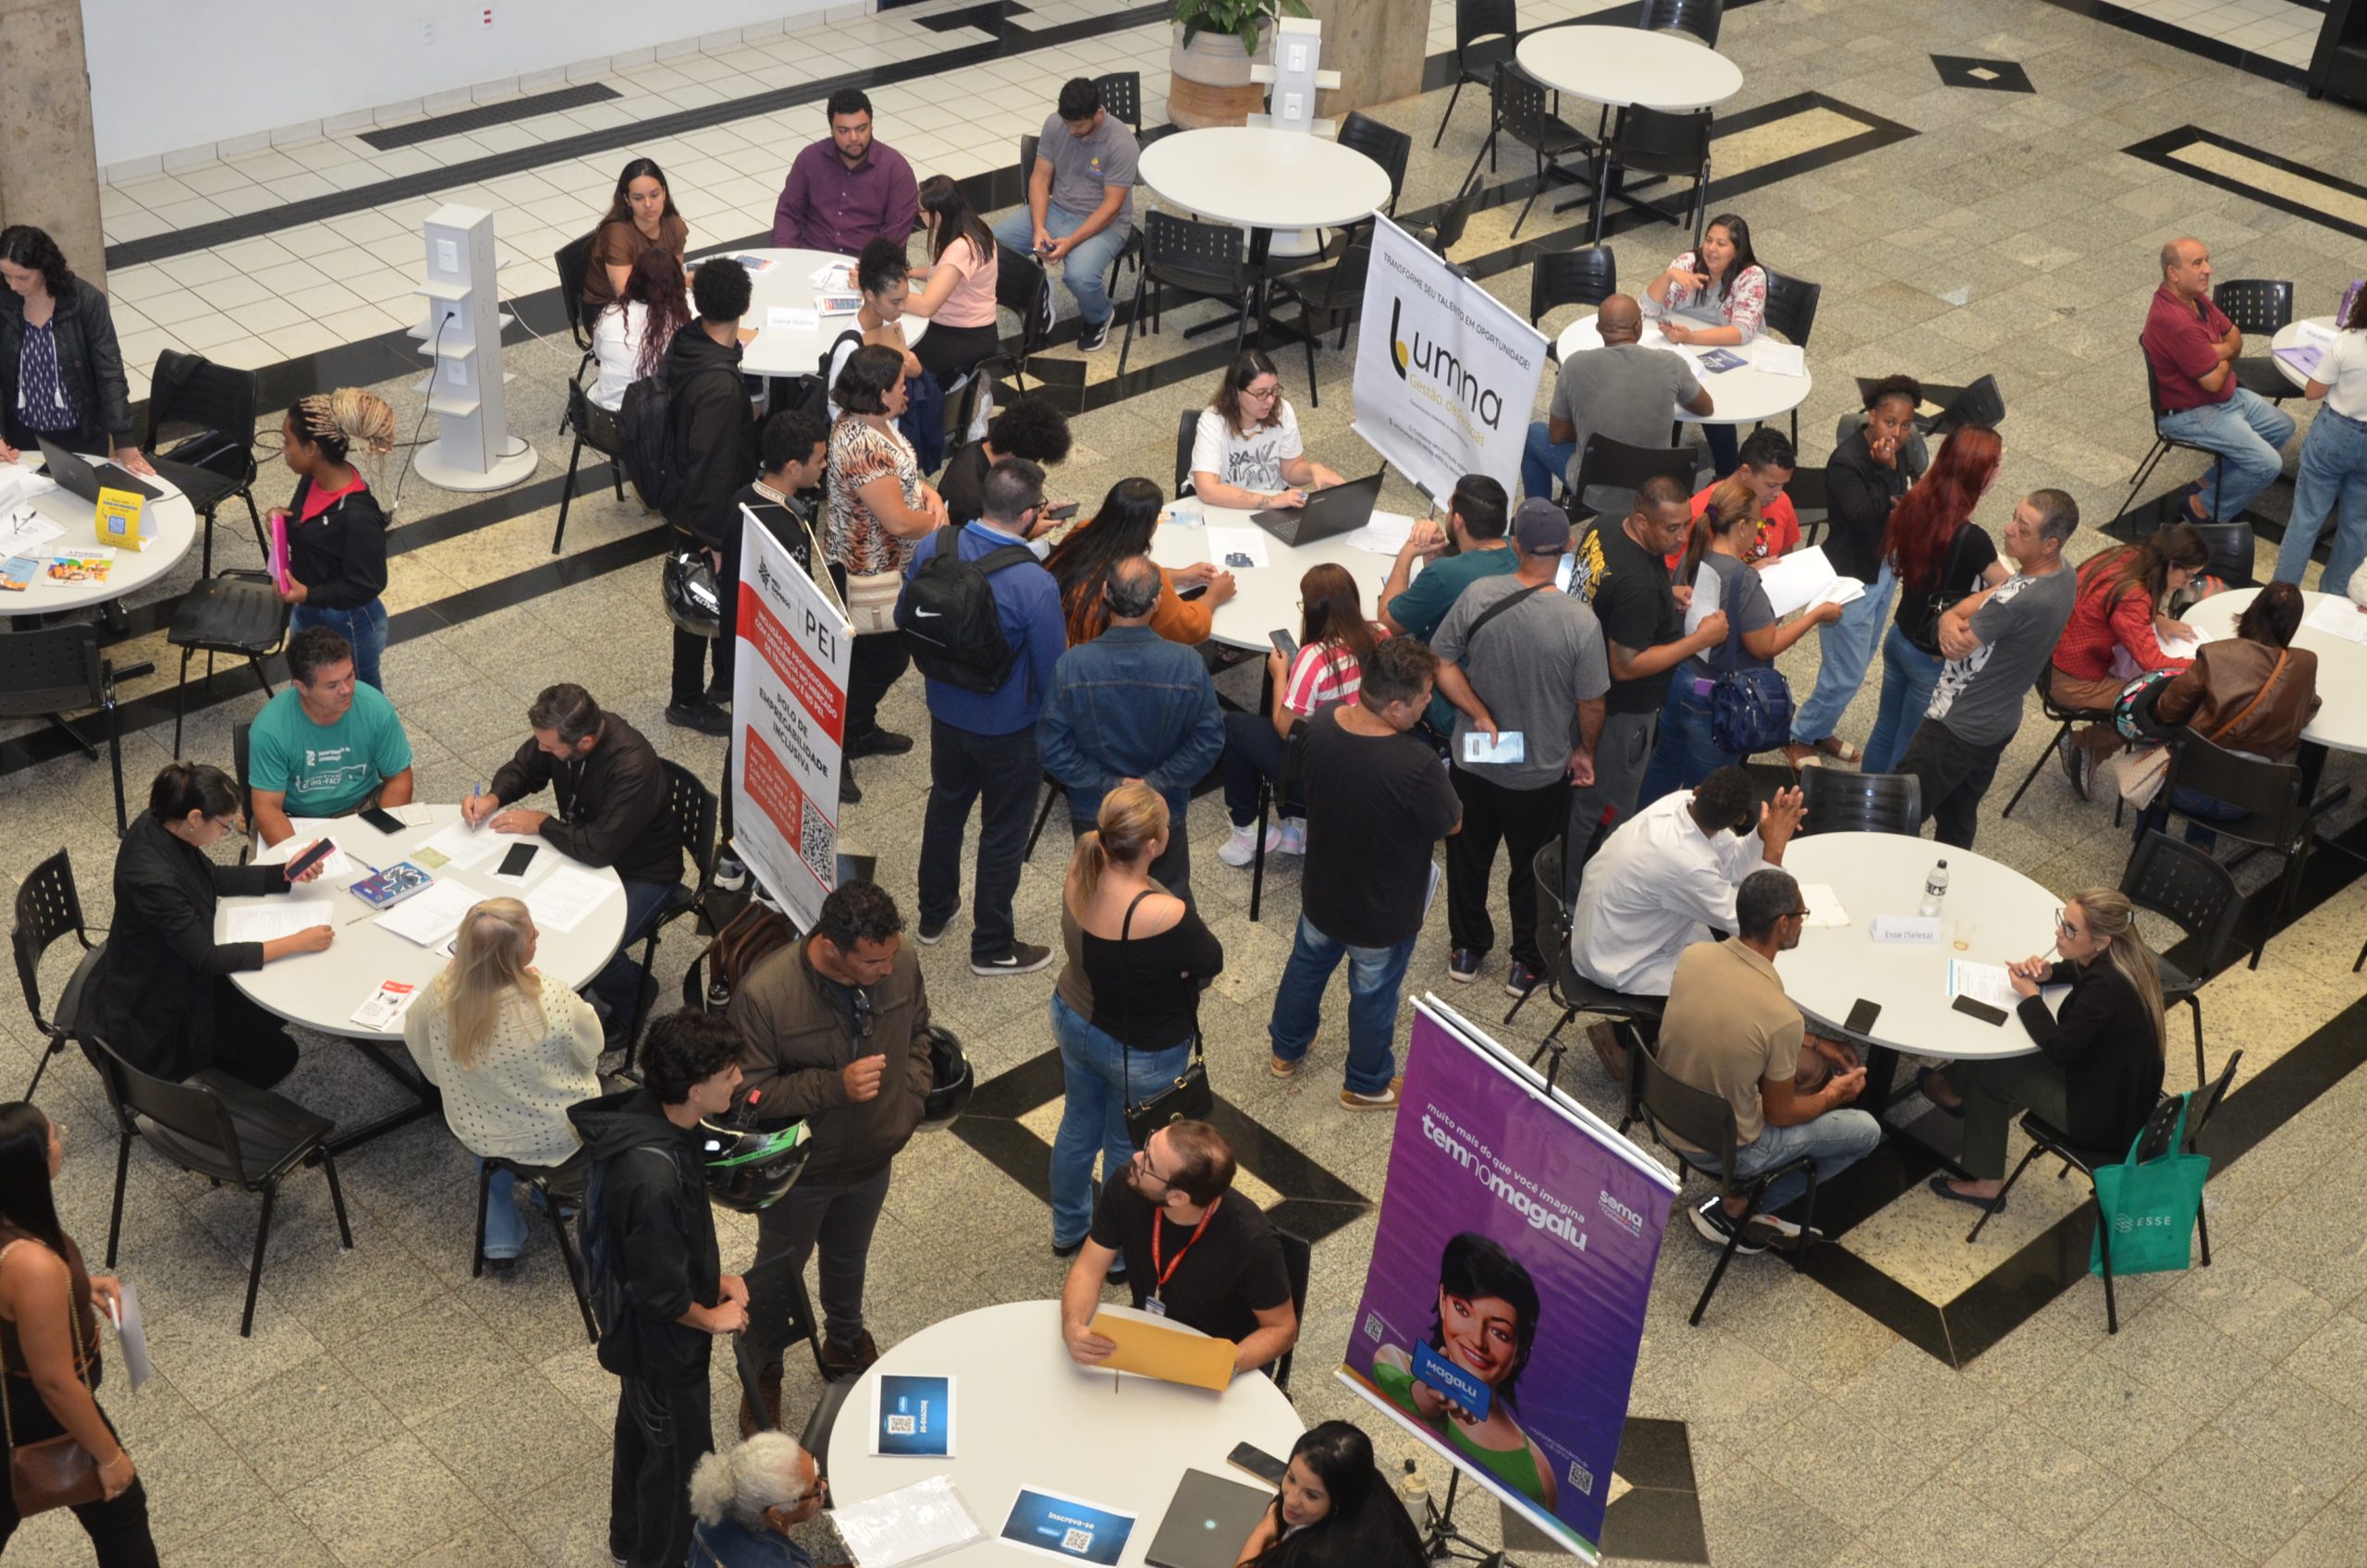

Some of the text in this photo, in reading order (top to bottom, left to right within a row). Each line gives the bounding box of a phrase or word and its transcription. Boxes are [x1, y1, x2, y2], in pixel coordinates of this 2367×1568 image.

[1384, 251, 1531, 372] TRANSFORME SEU TALENTO EM OPORTUNIDADE!
[1390, 295, 1503, 432] Lumna
[1409, 374, 1443, 406] Gestão
[758, 609, 783, 645] INCLUSÃO
[791, 650, 834, 704] PROFISSIONAIS
[805, 607, 836, 665] PEI
[754, 617, 767, 638] COM
[767, 631, 799, 676] DEFICIÊNCIA
[808, 680, 838, 719] MERCADO
[772, 650, 800, 690] TRABALHO
[804, 690, 814, 705] NO
[759, 686, 828, 778] EMPREGABILIDADE
[777, 692, 808, 739] POLO DE
[773, 720, 810, 776] INCLUSIVA
[1885, 930, 1933, 940] Esse (Seleta)
[1422, 1113, 1588, 1252] temnomagalu
[1427, 1102, 1585, 1224] muito mais do que você imagina
[2137, 1215, 2172, 1227] ESSE
[1048, 1511, 1095, 1529] Inscreva-se
